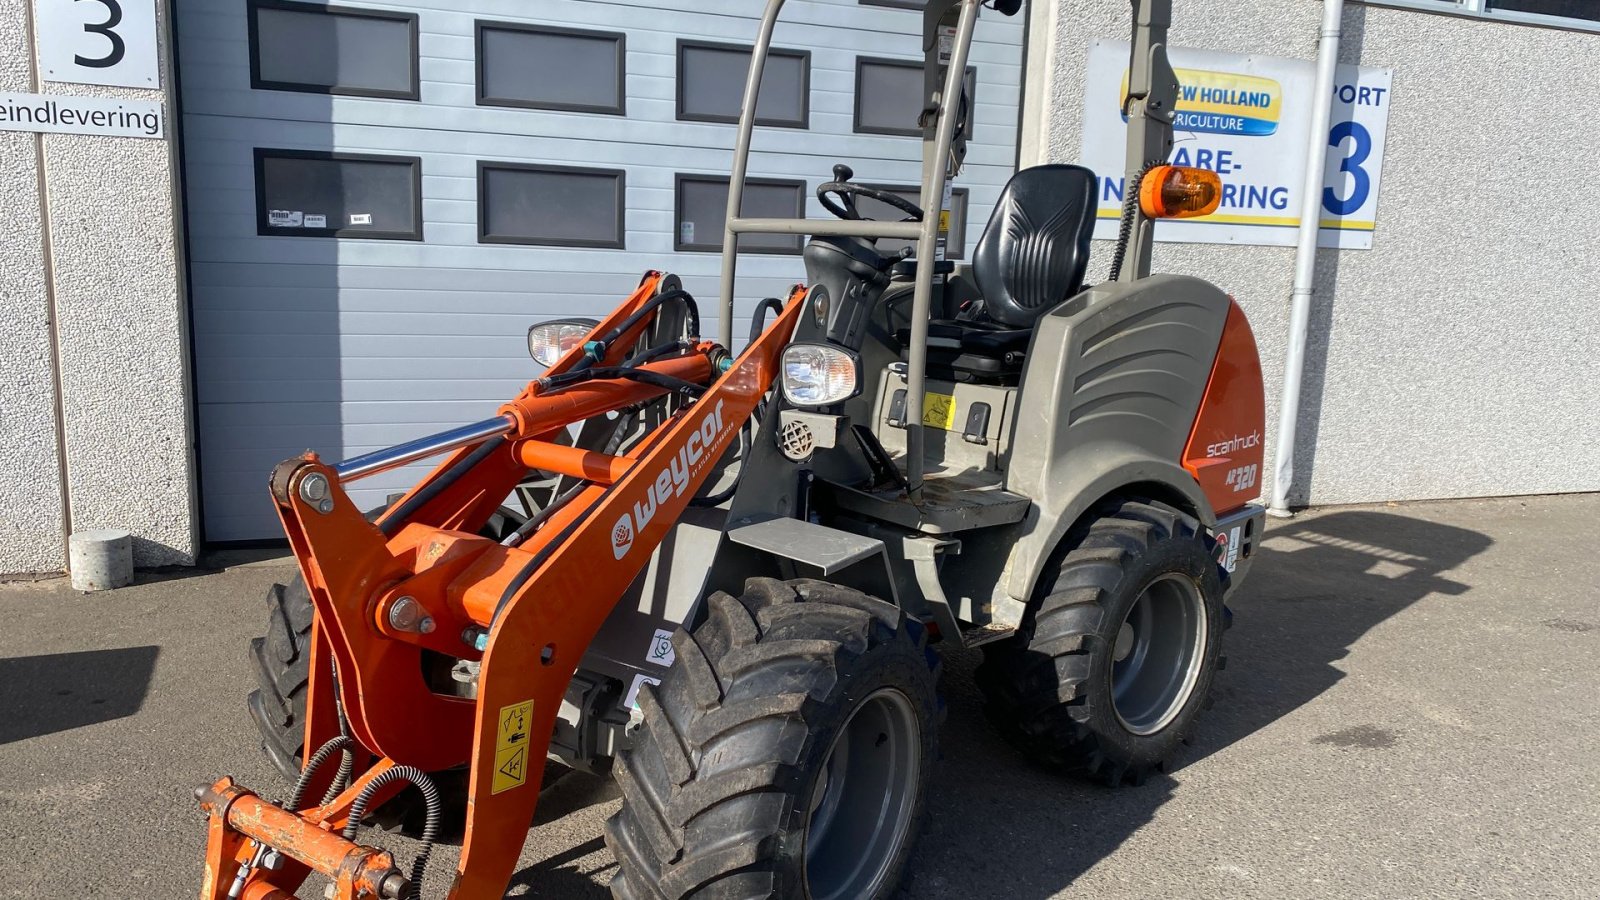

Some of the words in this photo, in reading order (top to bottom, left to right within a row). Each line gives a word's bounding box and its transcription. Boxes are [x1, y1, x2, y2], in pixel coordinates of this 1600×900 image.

[73, 0, 126, 68] 3
[1200, 87, 1271, 108] HOLLAND
[1173, 113, 1244, 131] RICULTURE
[1172, 147, 1242, 174] ARE-
[1322, 121, 1371, 215] 3
[1206, 429, 1260, 458] scantruck
[633, 398, 725, 533] weycor
